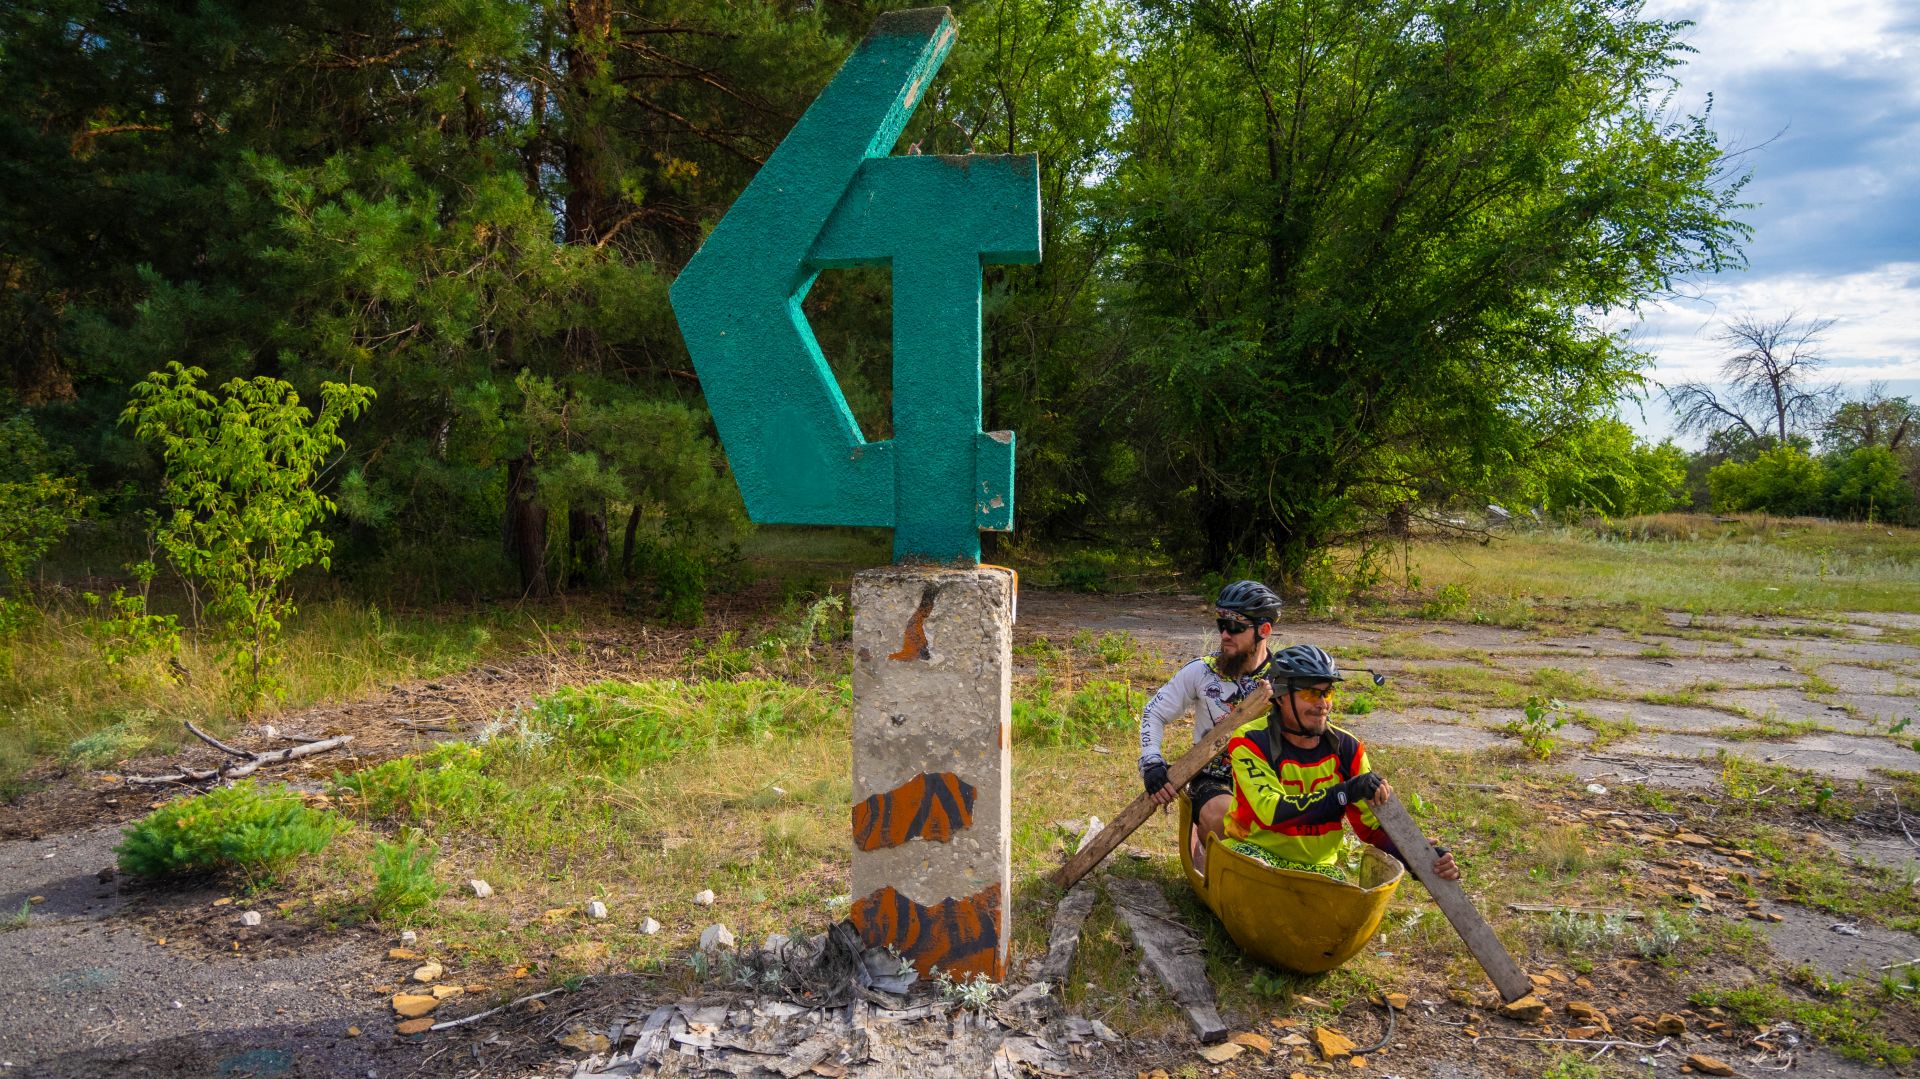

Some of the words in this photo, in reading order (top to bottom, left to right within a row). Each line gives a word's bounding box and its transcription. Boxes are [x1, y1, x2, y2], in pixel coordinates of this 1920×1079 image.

[1141, 731, 1151, 747] FOX
[1238, 757, 1274, 793] FOX
[1296, 824, 1321, 836] FOX
